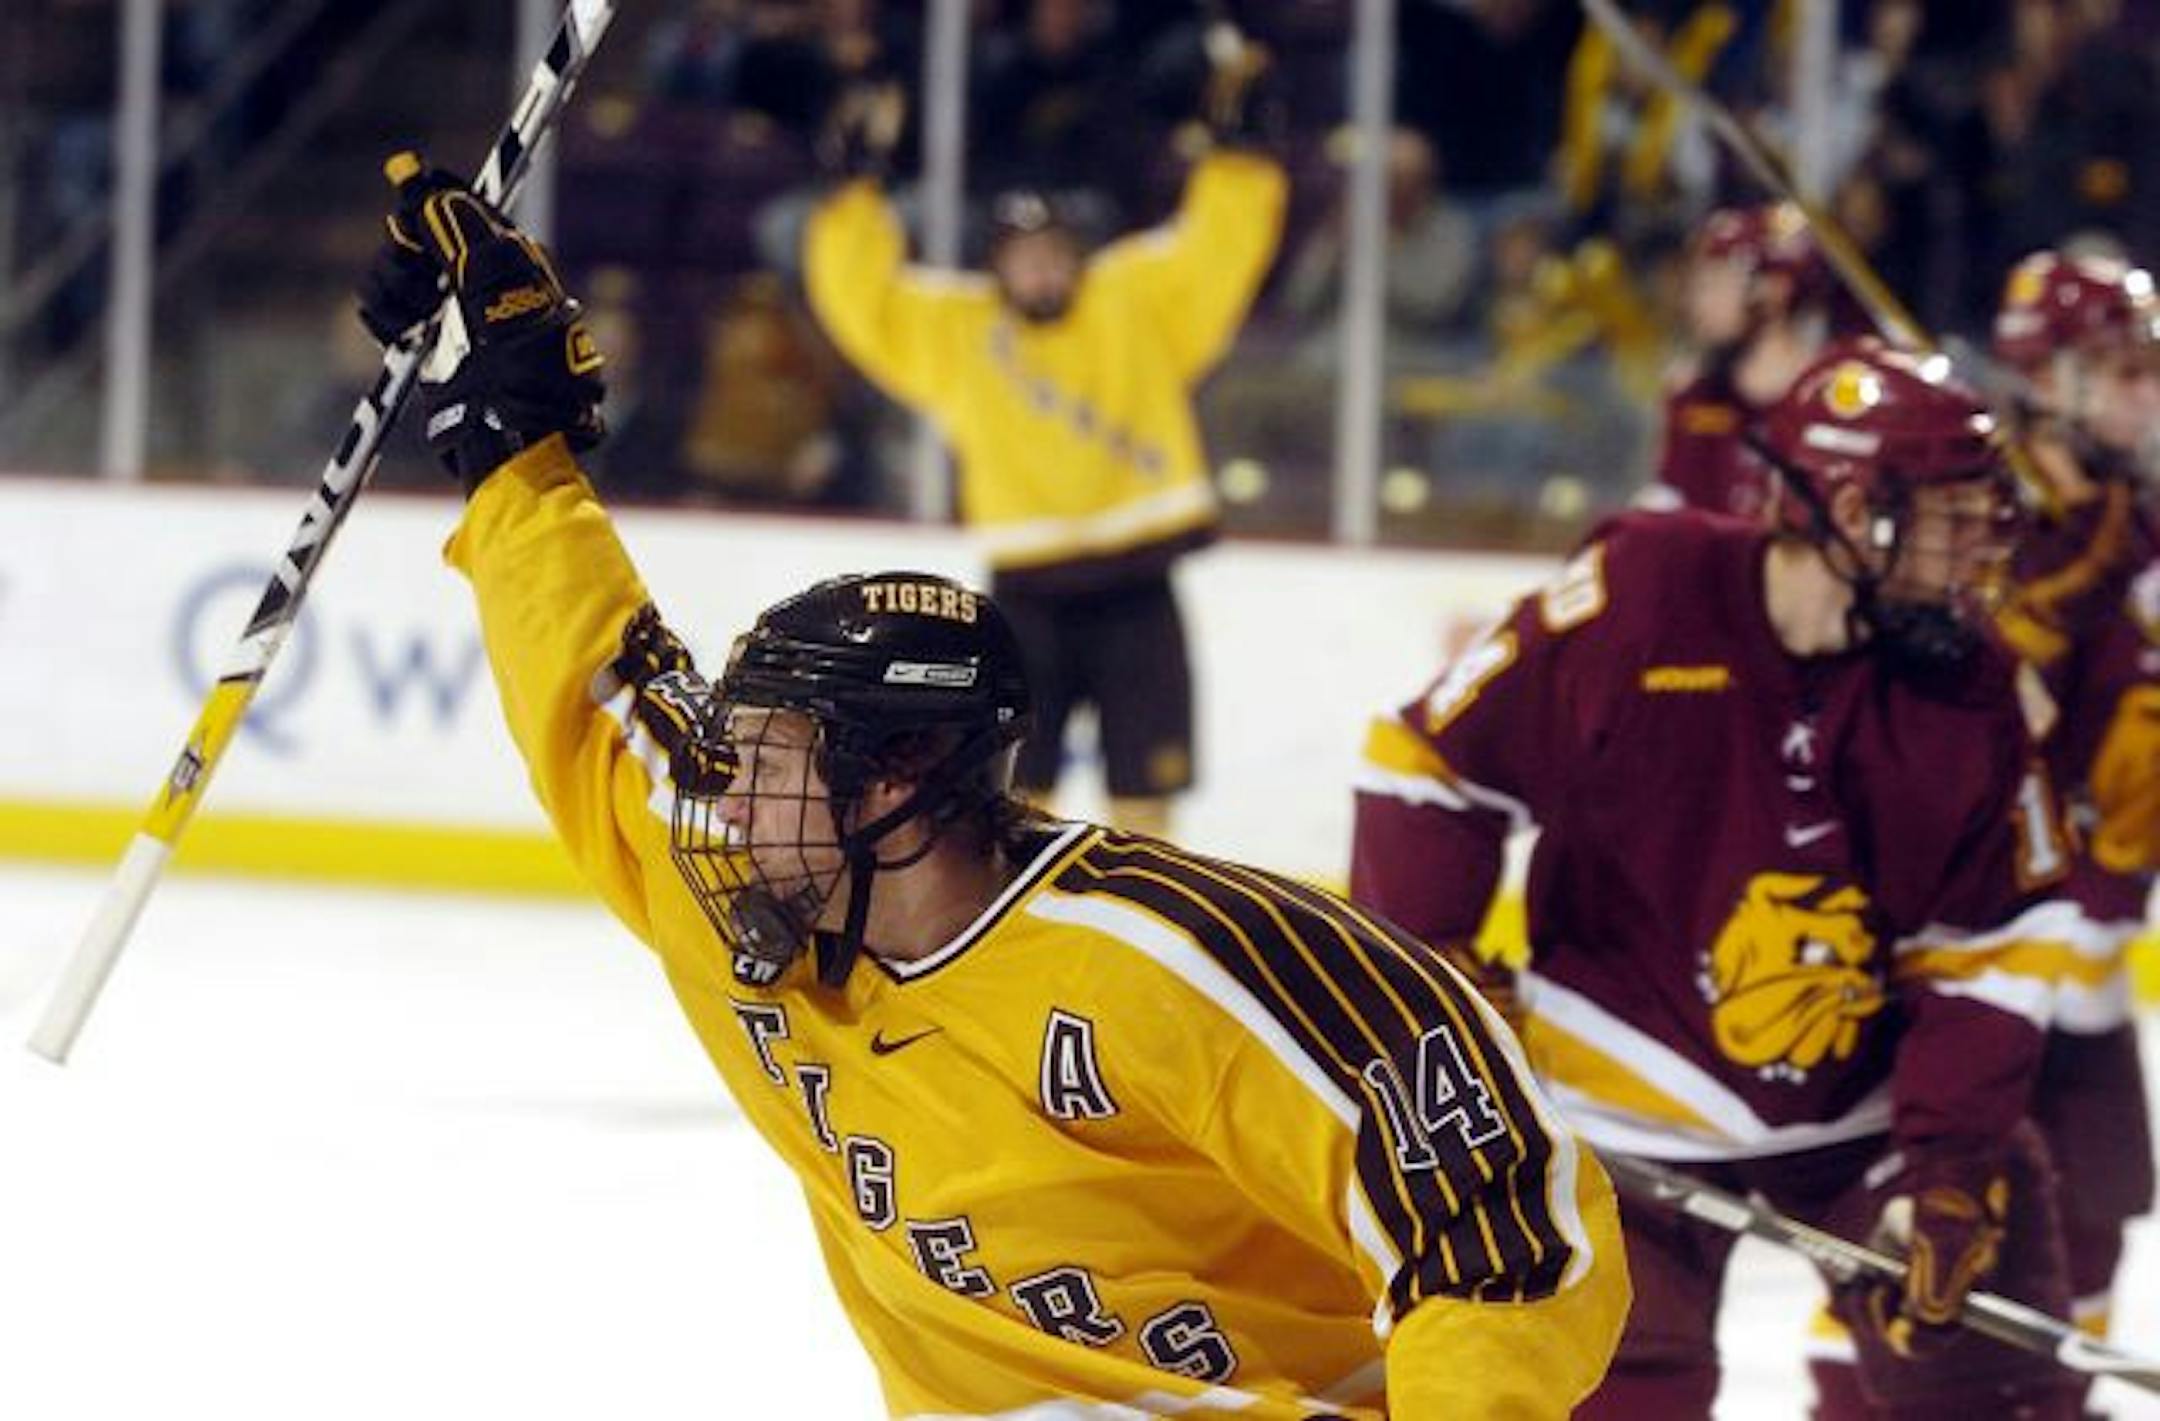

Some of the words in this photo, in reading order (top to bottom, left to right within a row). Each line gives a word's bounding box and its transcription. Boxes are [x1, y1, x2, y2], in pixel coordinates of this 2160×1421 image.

[862, 581, 978, 624] TIGERS
[1038, 1007, 1117, 1120] A
[1362, 1023, 1507, 1171] 14
[728, 996, 1237, 1385] TIGERS
